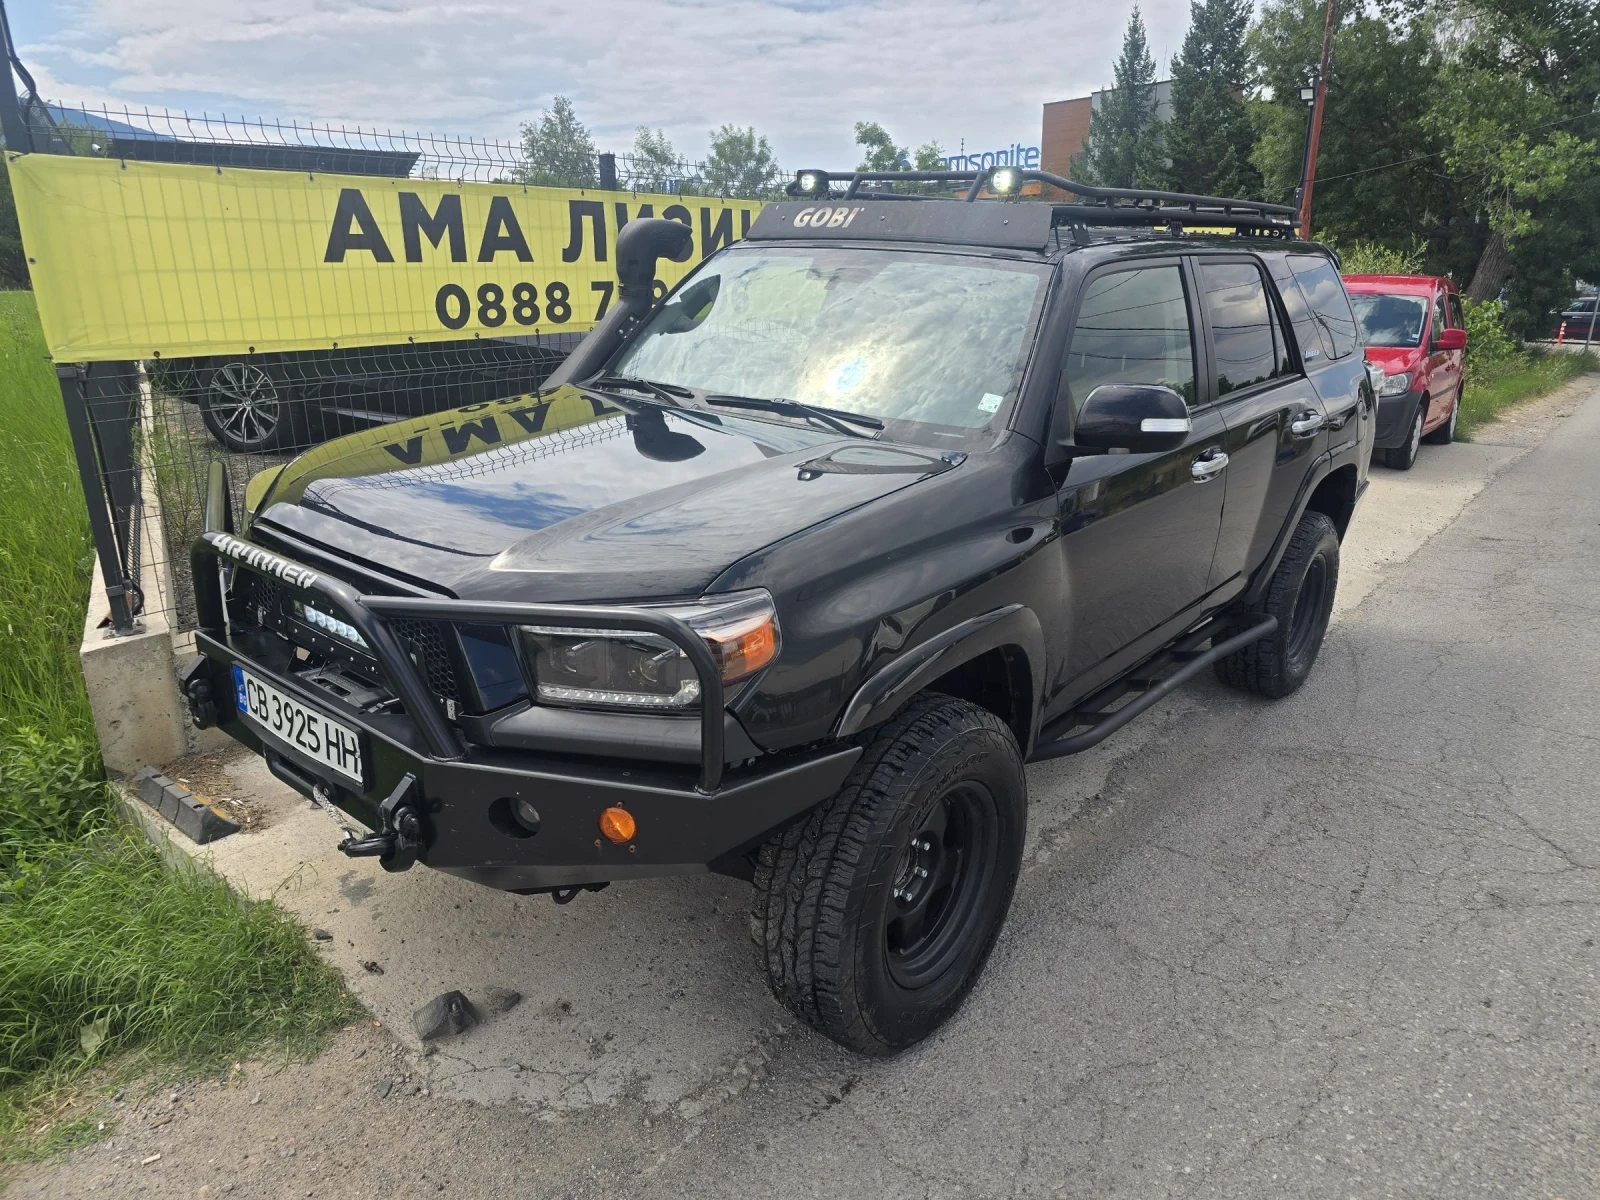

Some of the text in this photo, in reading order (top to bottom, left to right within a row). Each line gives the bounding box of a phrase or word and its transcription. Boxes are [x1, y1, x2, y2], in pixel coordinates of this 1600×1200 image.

[939, 143, 1040, 171] msonite
[323, 188, 535, 263] АМА
[793, 207, 860, 228] GOBI
[435, 281, 572, 330] 0888
[272, 694, 321, 753] 3925
